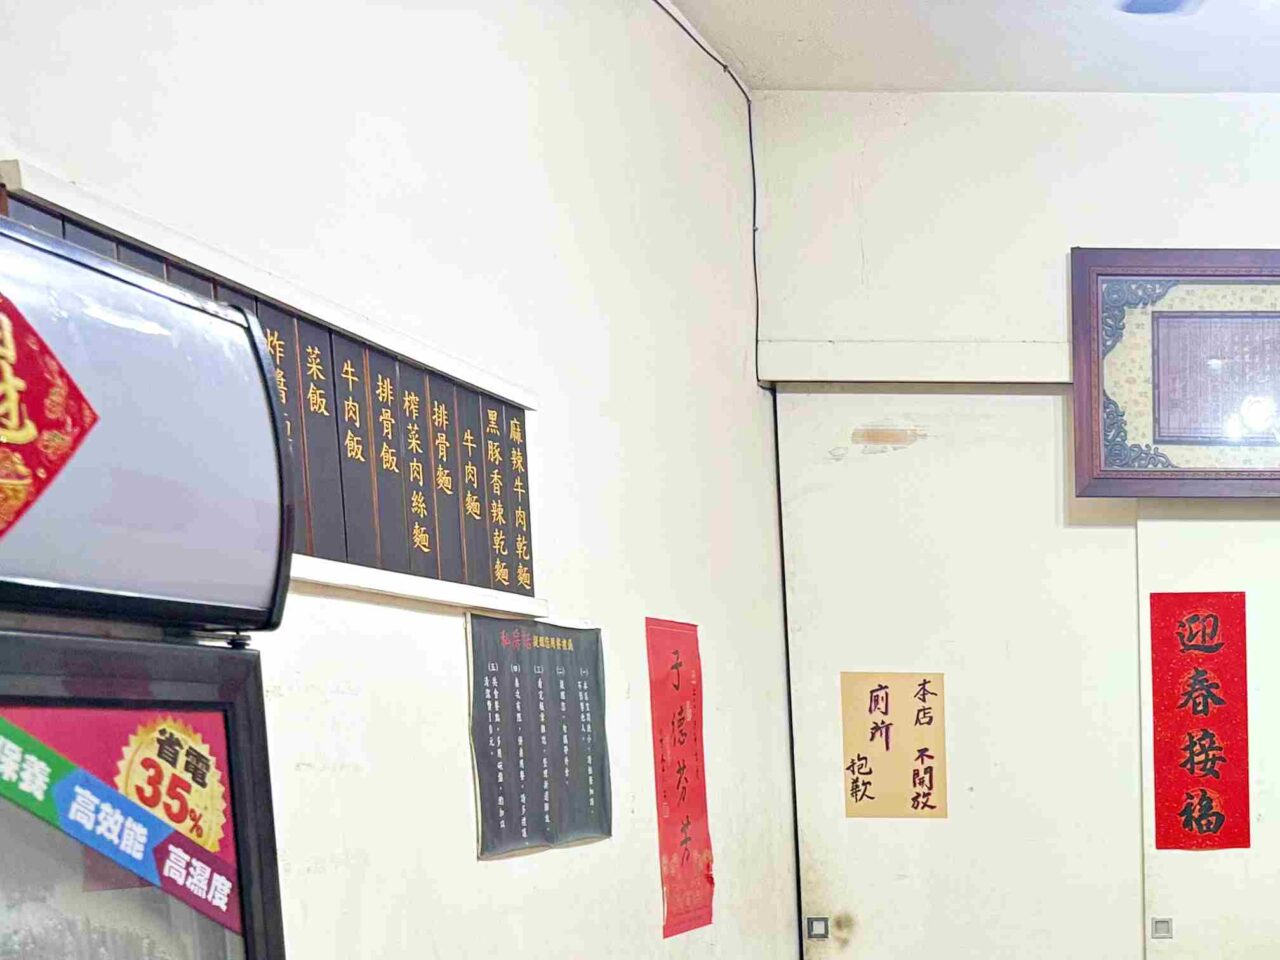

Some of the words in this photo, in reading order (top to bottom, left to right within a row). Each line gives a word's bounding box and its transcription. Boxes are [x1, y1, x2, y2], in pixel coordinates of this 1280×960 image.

[306, 345, 330, 416] 菜飯
[341, 359, 366, 462] 牛肉飯
[376, 374, 400, 473] 排骨飯
[402, 390, 432, 553] 榨菜肉絲麵
[432, 400, 454, 495] 排骨麵
[462, 429, 482, 520] 牛肉麵
[485, 408, 510, 586] 黑豚香辣乾麵
[509, 417, 532, 590] 麻辣牛肉乾麵
[914, 679, 938, 726] 本店
[1176, 613, 1226, 835] 迎春接福
[135, 757, 204, 838] 35%
[156, 728, 211, 789] 省電
[911, 747, 936, 810] 不開放
[68, 785, 148, 861] 高效能
